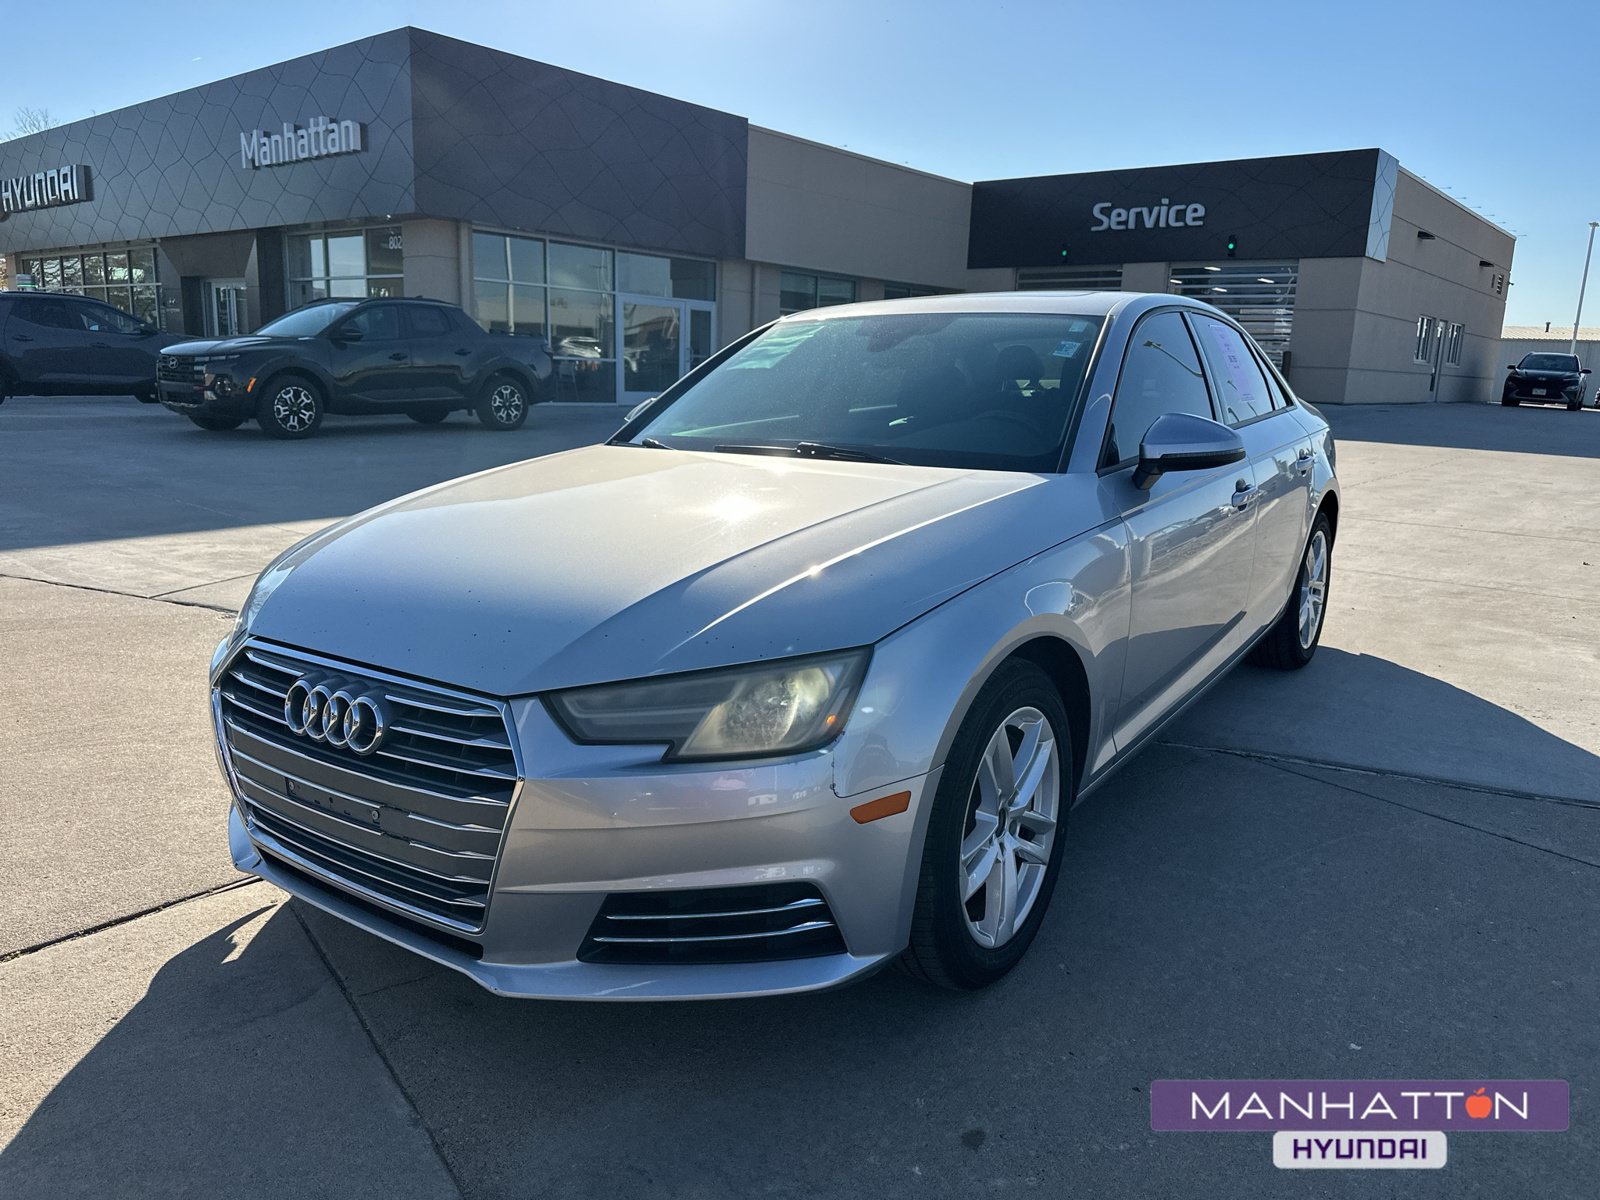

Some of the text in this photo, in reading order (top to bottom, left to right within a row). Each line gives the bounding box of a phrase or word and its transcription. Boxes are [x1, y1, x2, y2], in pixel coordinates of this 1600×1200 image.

[240, 115, 356, 169] Manhattan
[1, 164, 79, 212] HYUNDAI
[1090, 198, 1206, 231] Service
